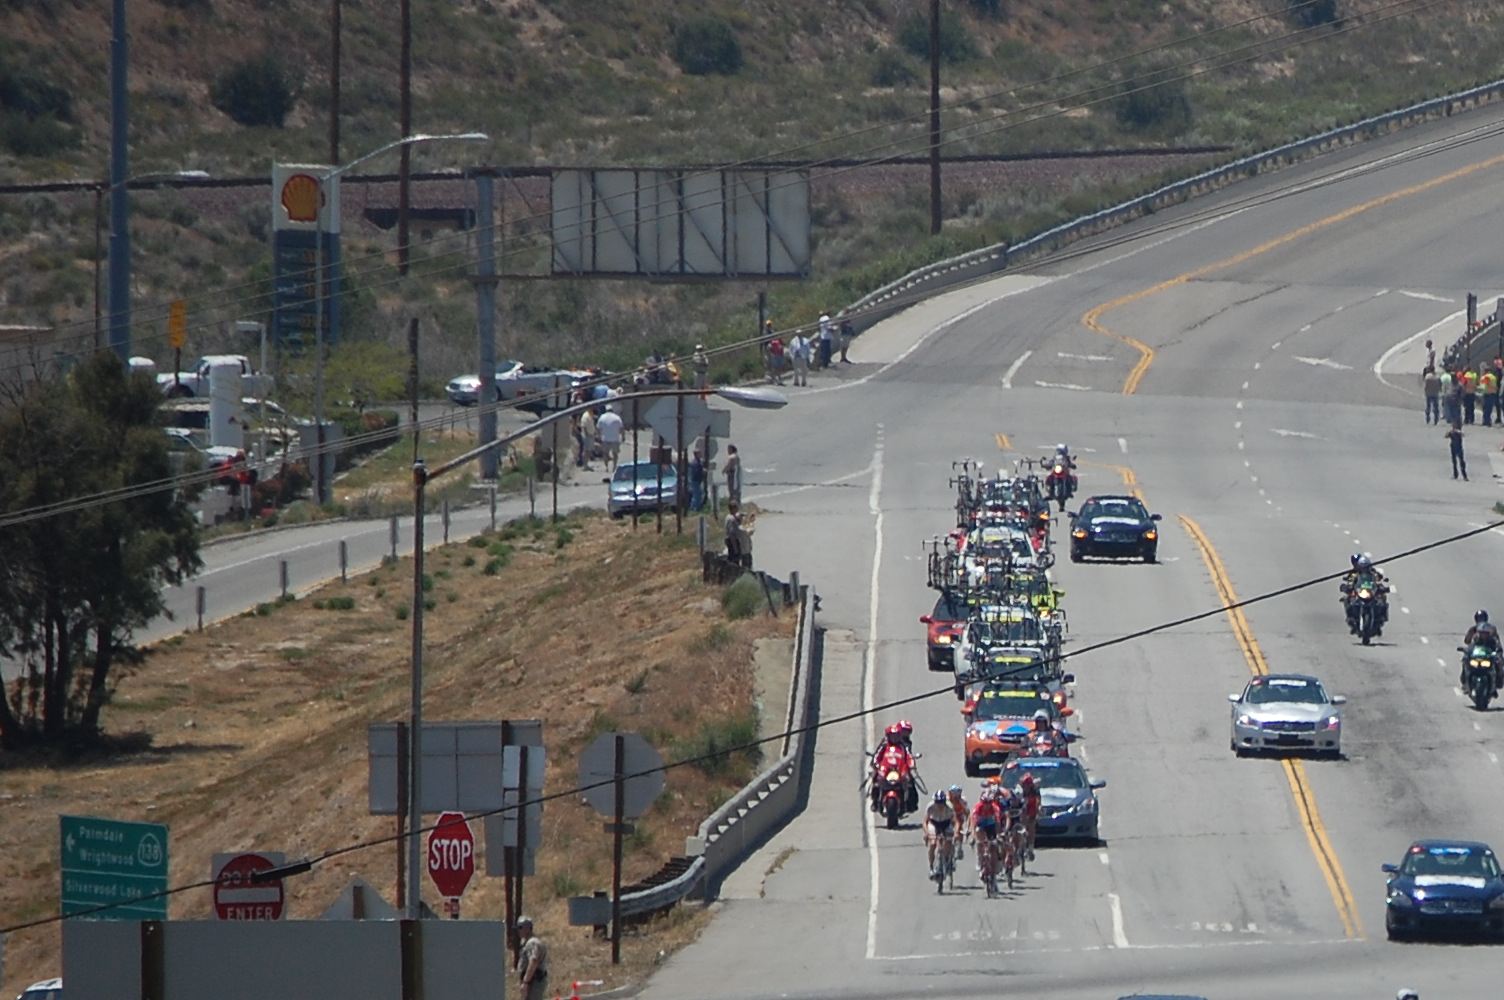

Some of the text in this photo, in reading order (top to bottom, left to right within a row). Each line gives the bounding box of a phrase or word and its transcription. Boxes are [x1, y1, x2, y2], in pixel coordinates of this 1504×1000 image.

[79, 826, 124, 843] Palmdale
[79, 849, 134, 867] Wrightwood
[140, 843, 159, 861] 138
[430, 838, 471, 871] STOP
[65, 879, 117, 896] Silverwood
[227, 906, 274, 921] ENTER
